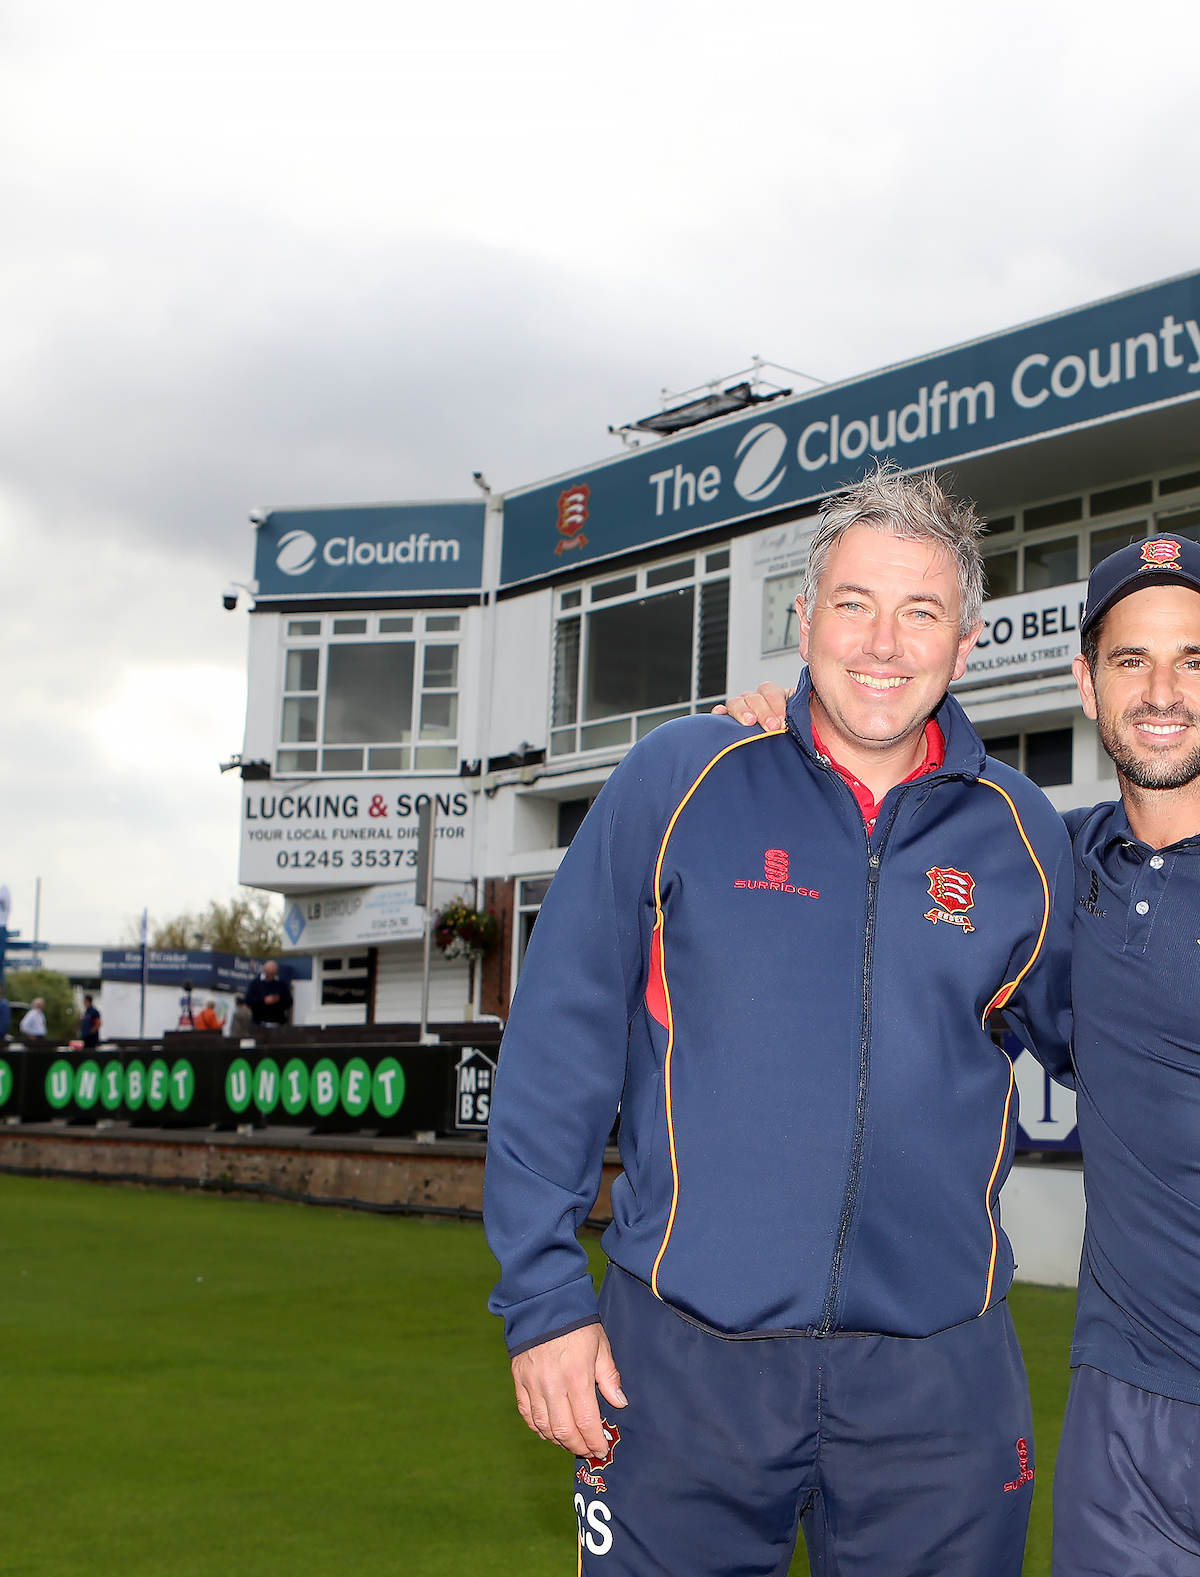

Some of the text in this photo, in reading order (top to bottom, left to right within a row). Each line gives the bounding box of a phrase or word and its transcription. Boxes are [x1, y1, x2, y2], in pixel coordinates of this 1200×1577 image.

[648, 464, 722, 516] The
[796, 380, 996, 472] Cloudfm
[323, 532, 461, 567] Cloudfm
[966, 644, 1070, 673] MOULSHAM STREET
[246, 795, 359, 819] LUCKING
[368, 794, 388, 818] &
[248, 827, 465, 841] YOUR LOCAL FUNERAL DIRTOR
[276, 850, 419, 868] 01245 35373
[733, 879, 821, 900] SURRIDGE
[50, 1069, 189, 1101] UNIBET
[230, 1069, 397, 1105] UNIBET
[460, 1093, 490, 1122] BS
